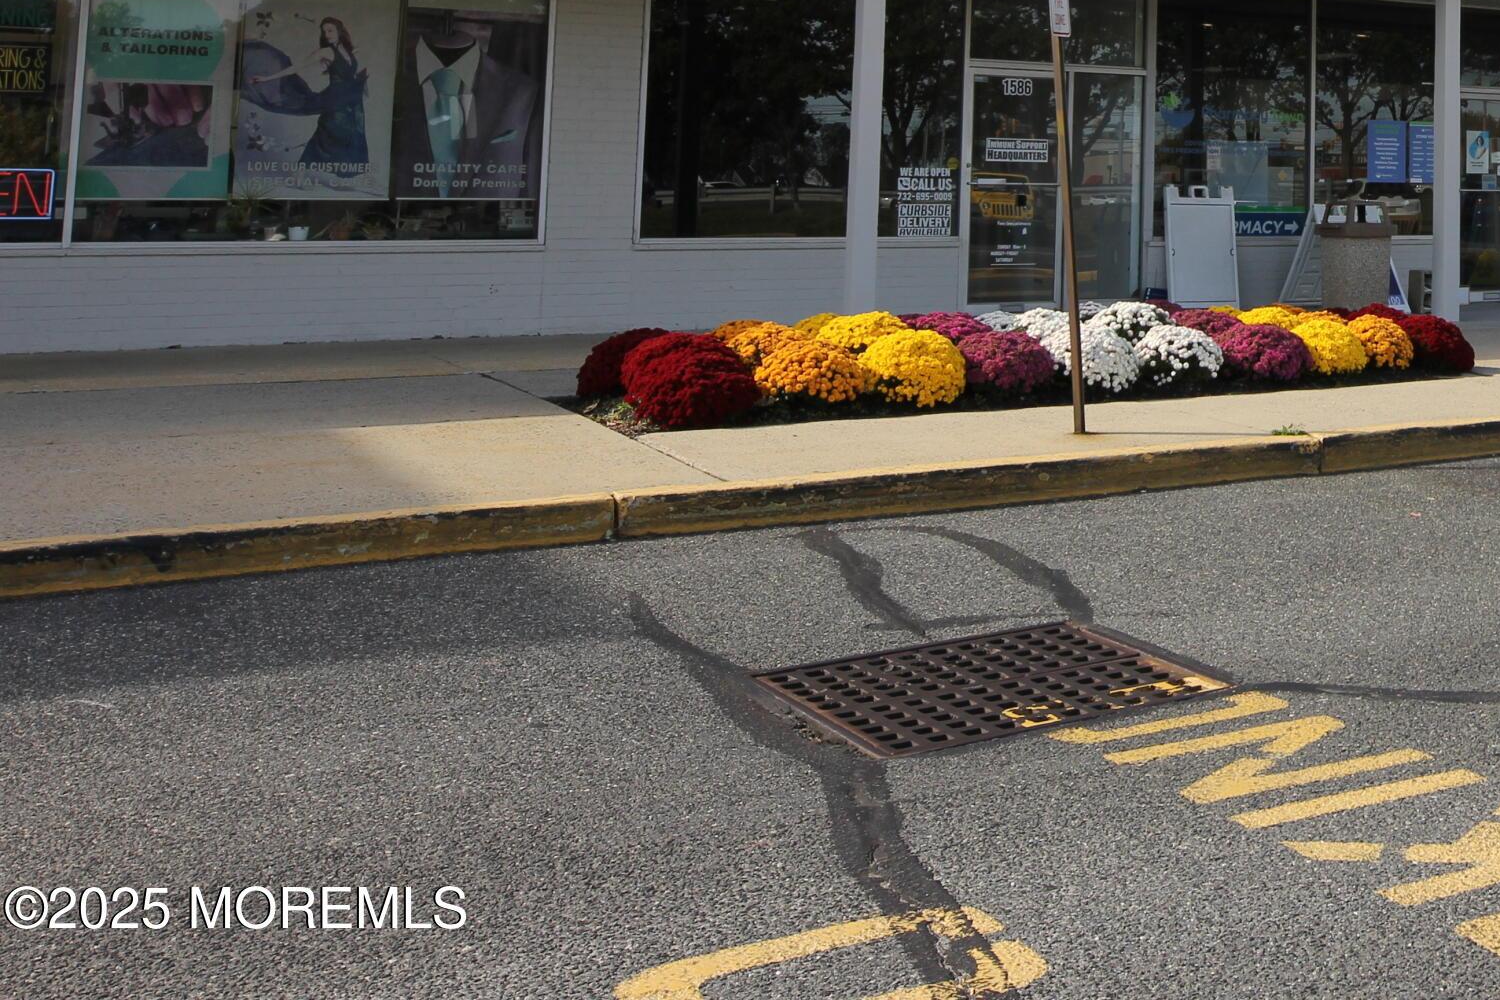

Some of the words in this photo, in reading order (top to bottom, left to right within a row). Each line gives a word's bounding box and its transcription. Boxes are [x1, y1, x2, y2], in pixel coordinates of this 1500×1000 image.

[98, 26, 214, 41] ALTERATIONS
[101, 43, 112, 53] &
[120, 43, 209, 56] TAILORING
[33, 48, 47, 69] &
[1002, 78, 1032, 96] 1586
[1015, 140, 1047, 150] SUPPORT
[987, 150, 1047, 160] HEADQUARTERS
[247, 161, 279, 172] LOVE
[282, 161, 307, 172] OUR
[413, 163, 482, 174] QUALITY
[486, 164, 528, 174] CARE
[900, 167, 913, 177] WE
[914, 168, 929, 177] ARE
[930, 168, 951, 177] OPEN
[249, 176, 323, 188] SPECIAL
[413, 177, 448, 188] Done
[452, 179, 469, 188] on
[472, 178, 527, 189] Premise
[911, 178, 936, 191] CALL
[938, 178, 953, 191] US
[899, 204, 951, 216] CURBSIDE
[899, 217, 950, 227] DELIVERY
[899, 228, 950, 236] AVAILABLE
